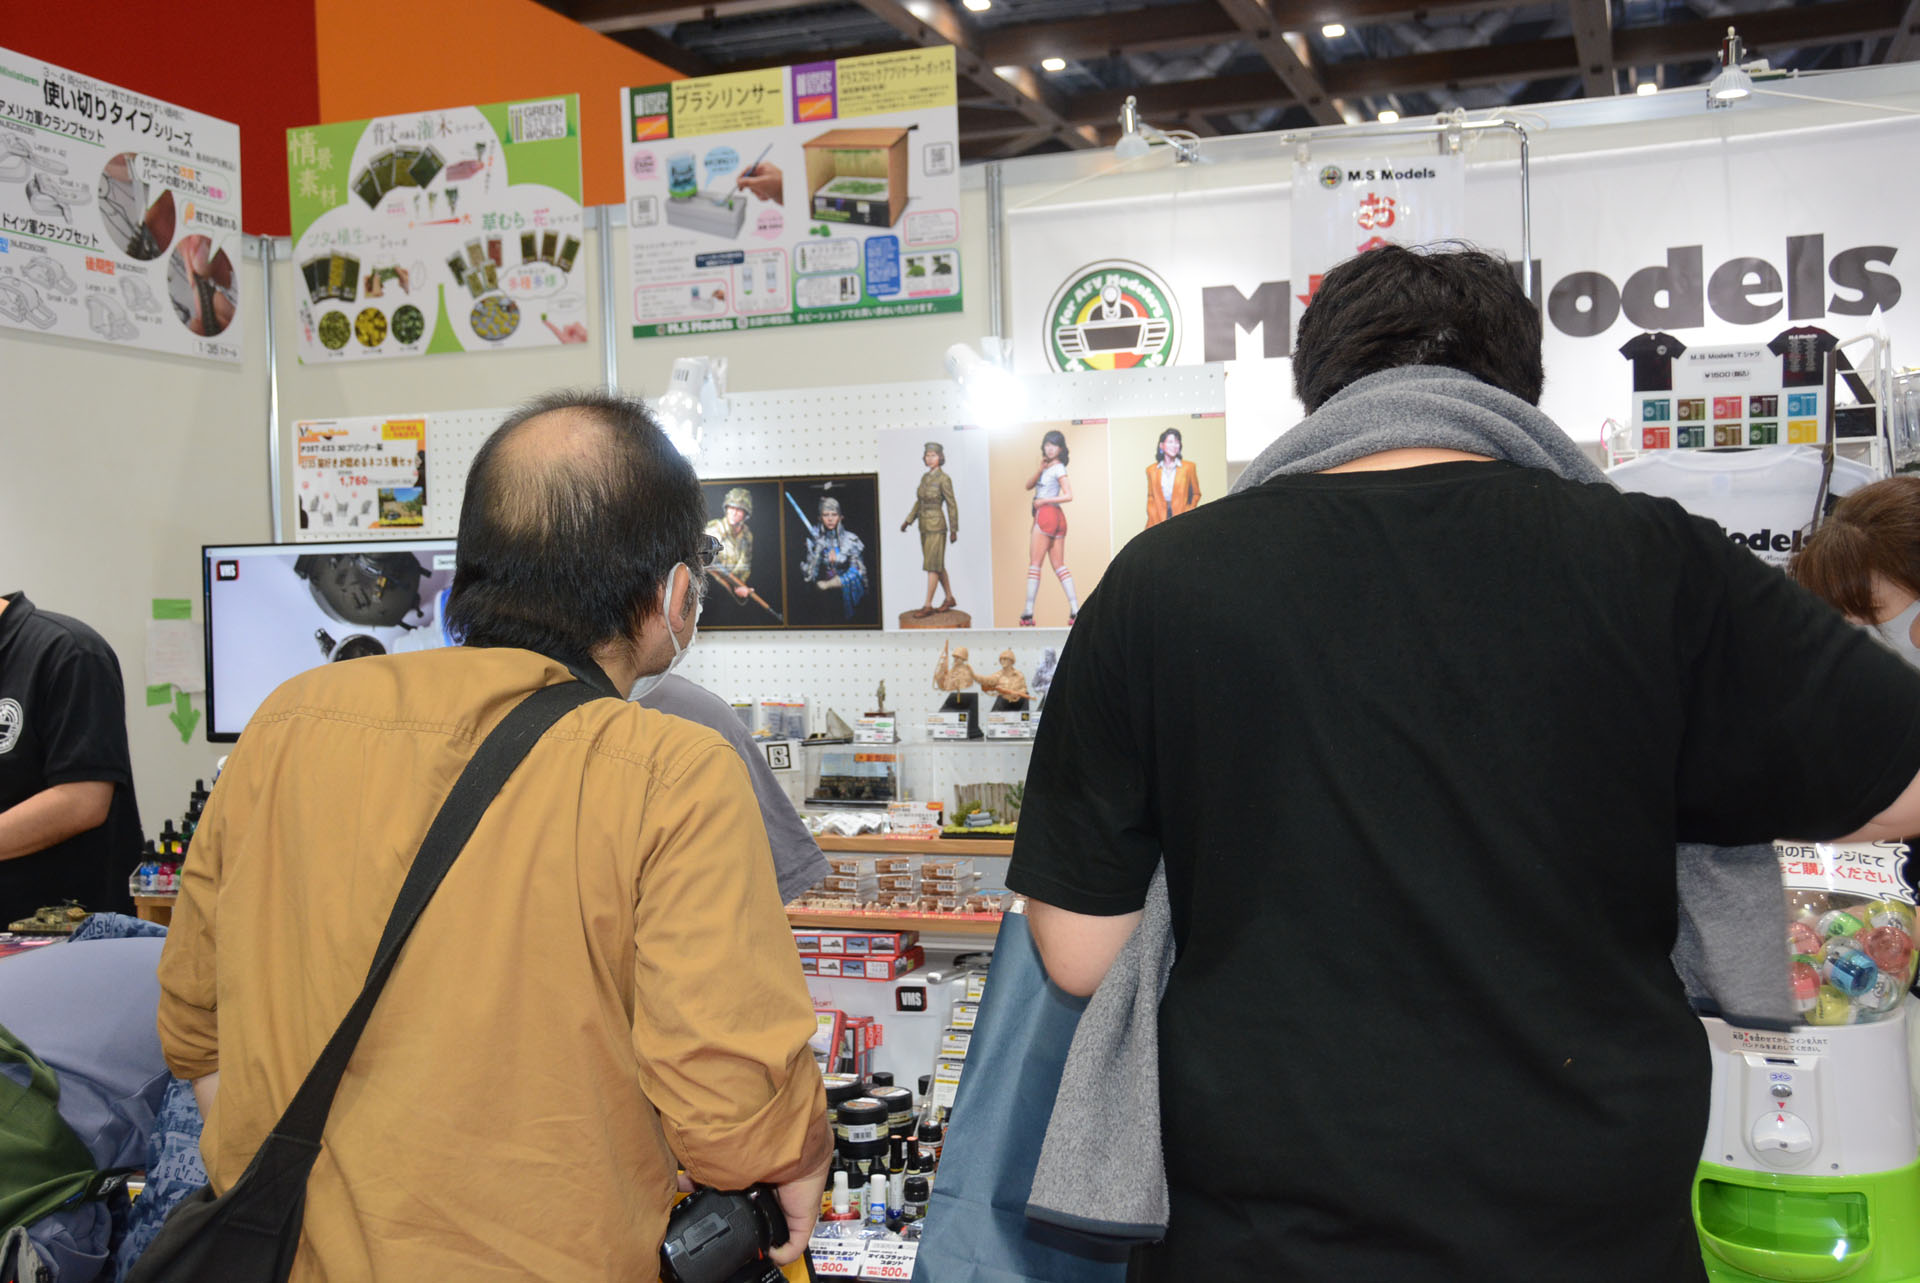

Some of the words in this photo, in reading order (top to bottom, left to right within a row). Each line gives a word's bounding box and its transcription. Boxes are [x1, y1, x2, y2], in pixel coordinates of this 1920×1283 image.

[676, 82, 781, 115] ブラシリンサー
[1348, 169, 1376, 181] M.S
[1381, 167, 1436, 181] Models
[1508, 233, 1901, 338] odels
[1059, 300, 1076, 325] for
[1074, 275, 1104, 303] AFV
[340, 475, 369, 488] 1,760
[1723, 528, 1812, 552] odel
[901, 992, 922, 1006] VMS
[1770, 1072, 1791, 1081] コイン
